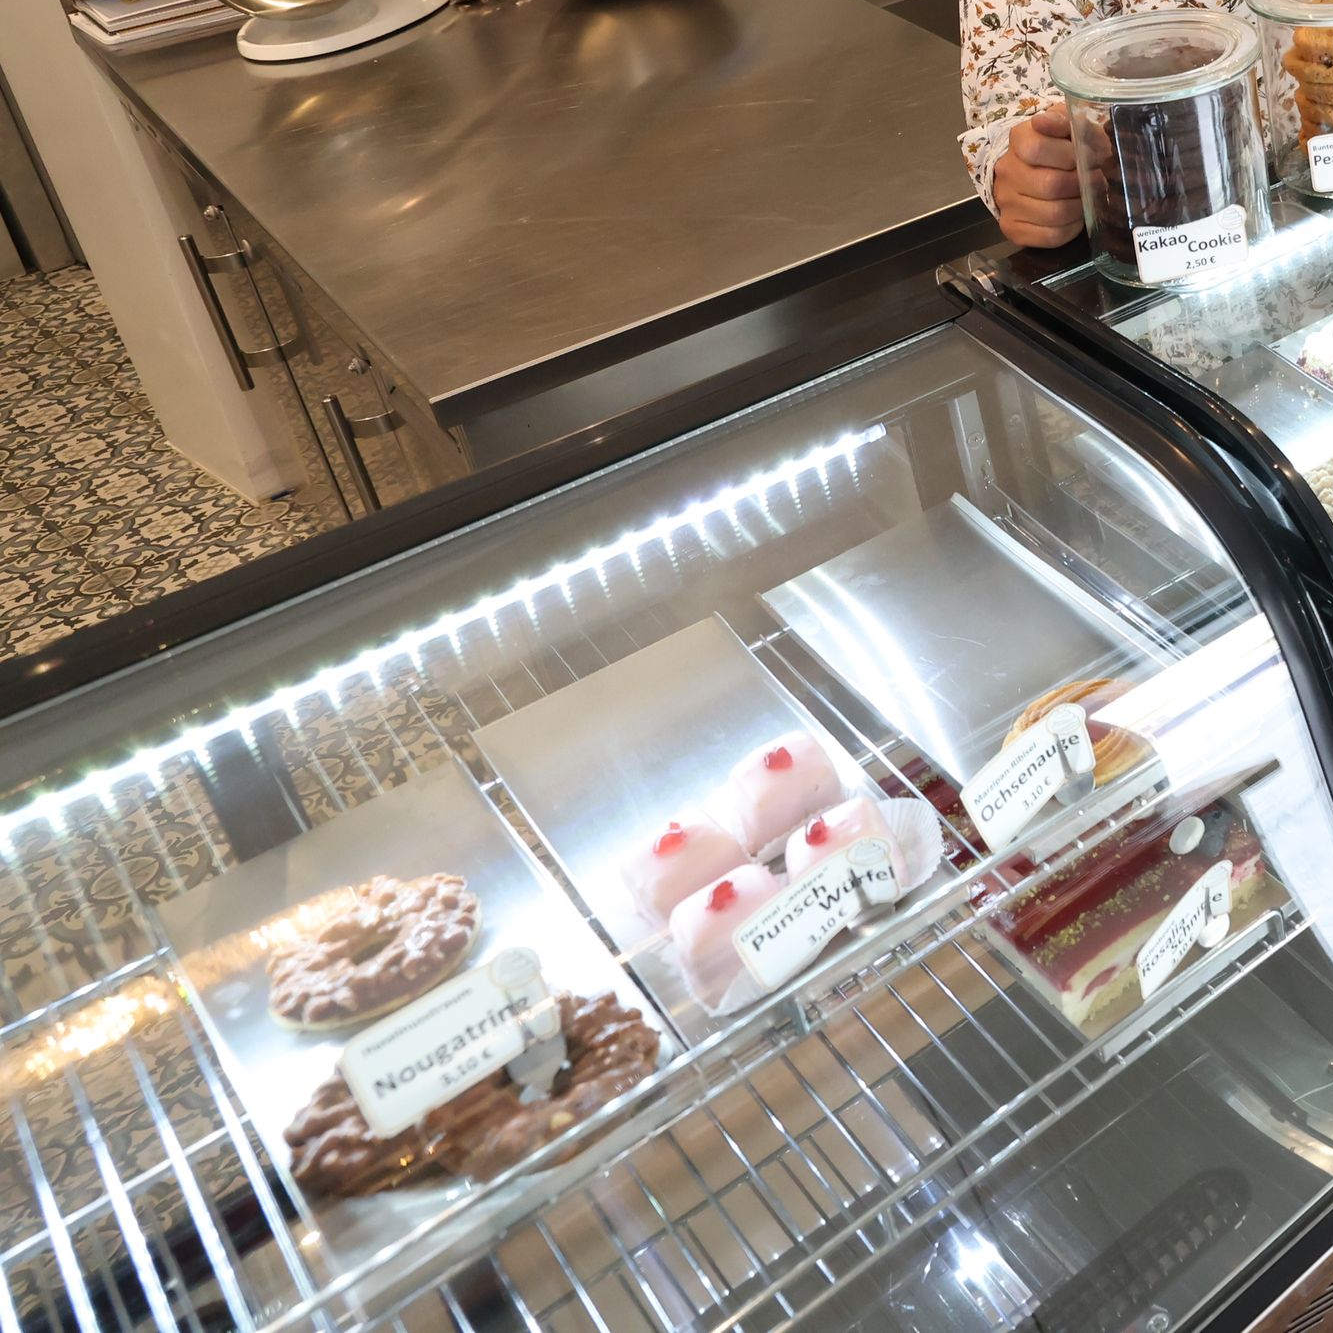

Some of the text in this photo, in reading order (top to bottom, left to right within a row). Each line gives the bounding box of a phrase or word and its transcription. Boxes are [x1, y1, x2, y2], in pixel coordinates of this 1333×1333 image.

[1312, 142, 1333, 152] Bunte
[1138, 232, 1242, 254] Kakao Cookie
[1186, 256, 1216, 270] 2,50 €
[980, 734, 1081, 822] Ochsenauge
[819, 866, 896, 912] Würfel
[752, 884, 828, 952] Punsch
[808, 916, 837, 946] 3,10
